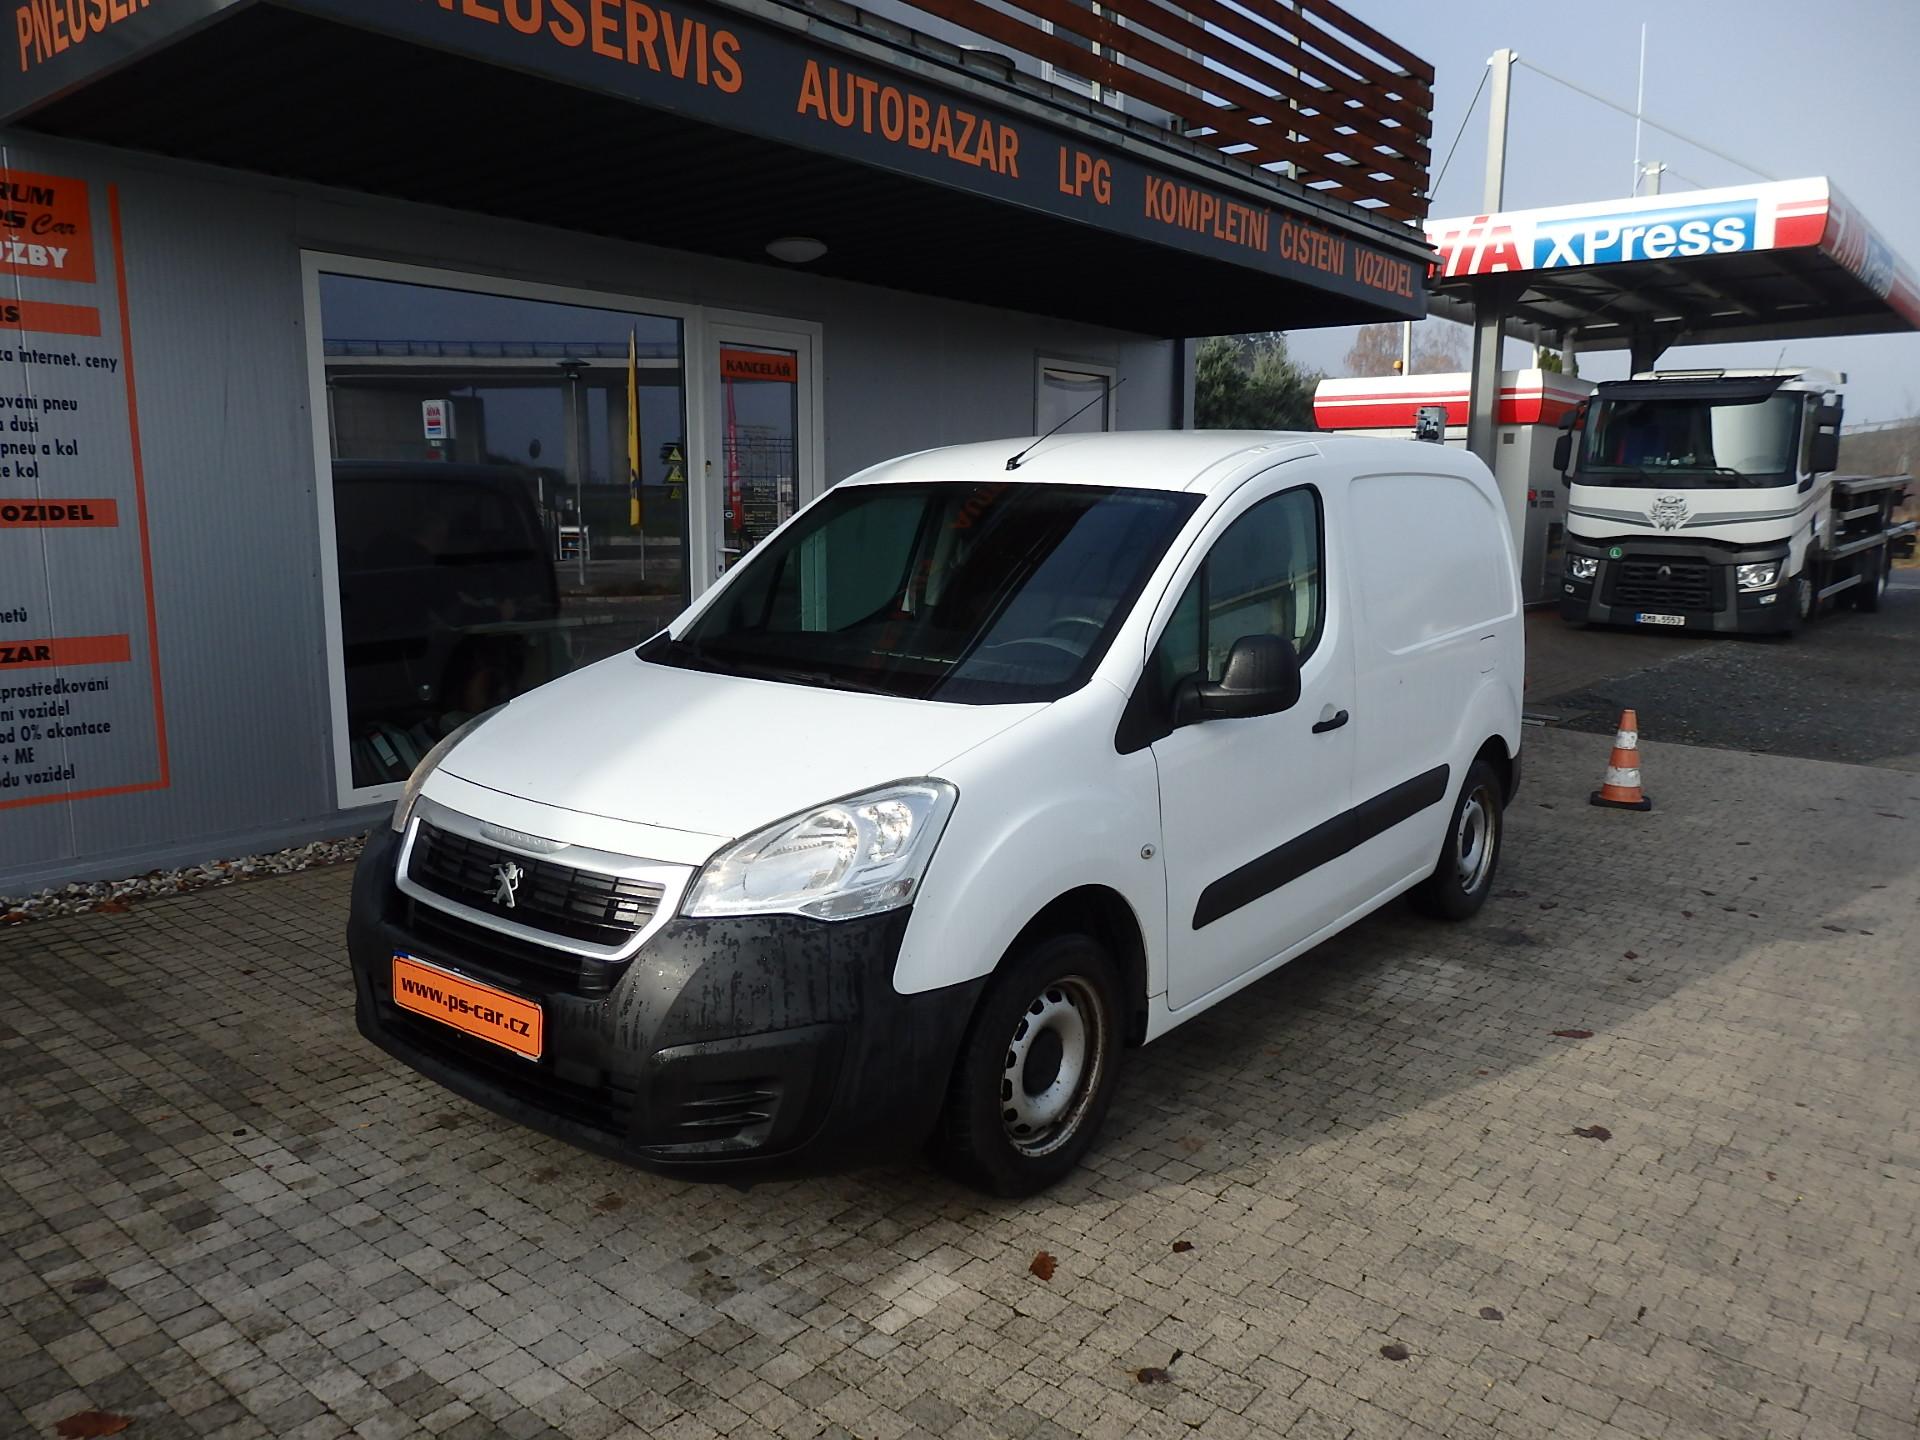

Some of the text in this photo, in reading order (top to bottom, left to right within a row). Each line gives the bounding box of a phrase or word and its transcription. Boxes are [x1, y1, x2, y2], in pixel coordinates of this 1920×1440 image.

[15, 0, 151, 73] PNEU
[417, 0, 744, 94] SERVIS
[796, 58, 1020, 179] AUTOBAZAR
[1058, 145, 1112, 206] LPG
[1145, 174, 1269, 253] KOMPLETNÍ
[1354, 247, 1414, 299] VOZIDEL
[0, 209, 78, 236] S Car
[0, 234, 68, 268] ŽBY
[18, 345, 81, 367] internet.
[85, 354, 118, 374] ceny
[43, 397, 78, 415] pneu
[0, 438, 79, 459] pneu a kol
[16, 460, 39, 479] kol
[0, 676, 110, 703] prostředkování
[19, 699, 71, 720] vozidel
[20, 724, 43, 744] 0%
[47, 721, 112, 740] akontace
[24, 763, 76, 785] vozidel
[401, 976, 530, 1039] www.ps-car.cz
